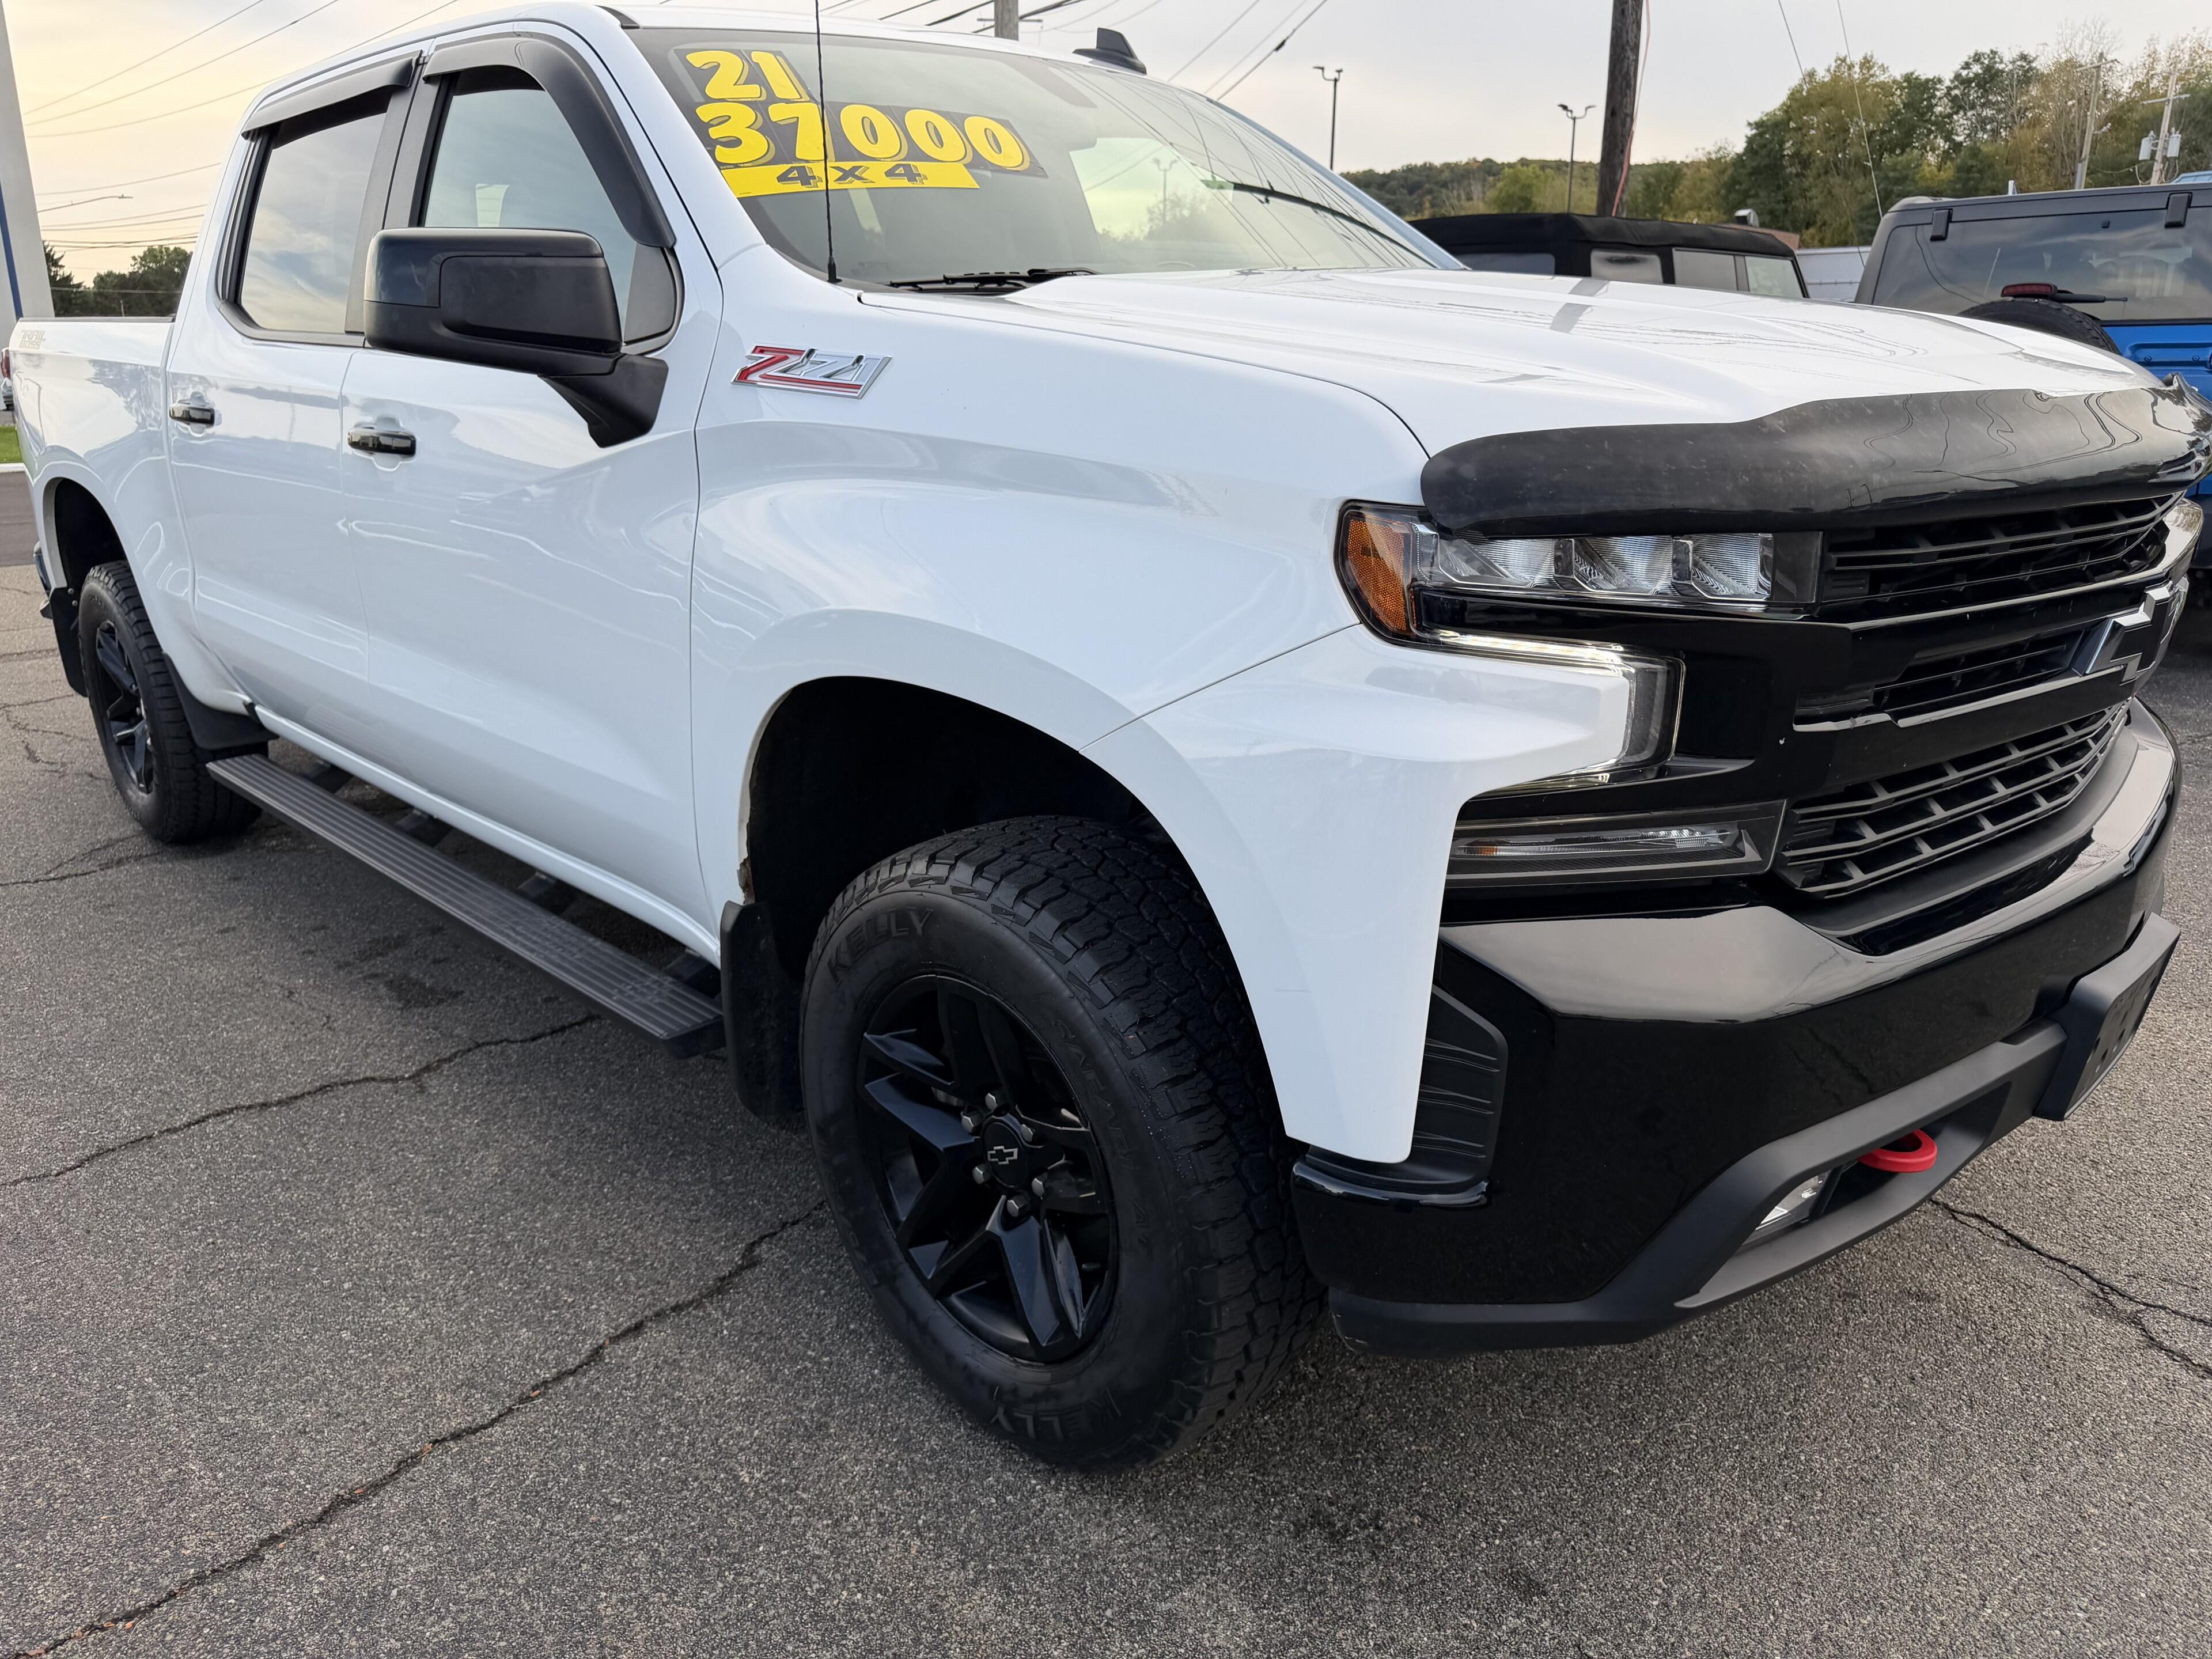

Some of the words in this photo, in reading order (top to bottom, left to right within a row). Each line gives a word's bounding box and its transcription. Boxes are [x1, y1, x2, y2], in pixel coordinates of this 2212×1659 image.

[686, 50, 809, 101] 21
[695, 102, 1031, 171] 37000
[21, 329, 46, 342] TRAIL
[730, 343, 892, 400] Z71
[828, 906, 935, 987] KELLY
